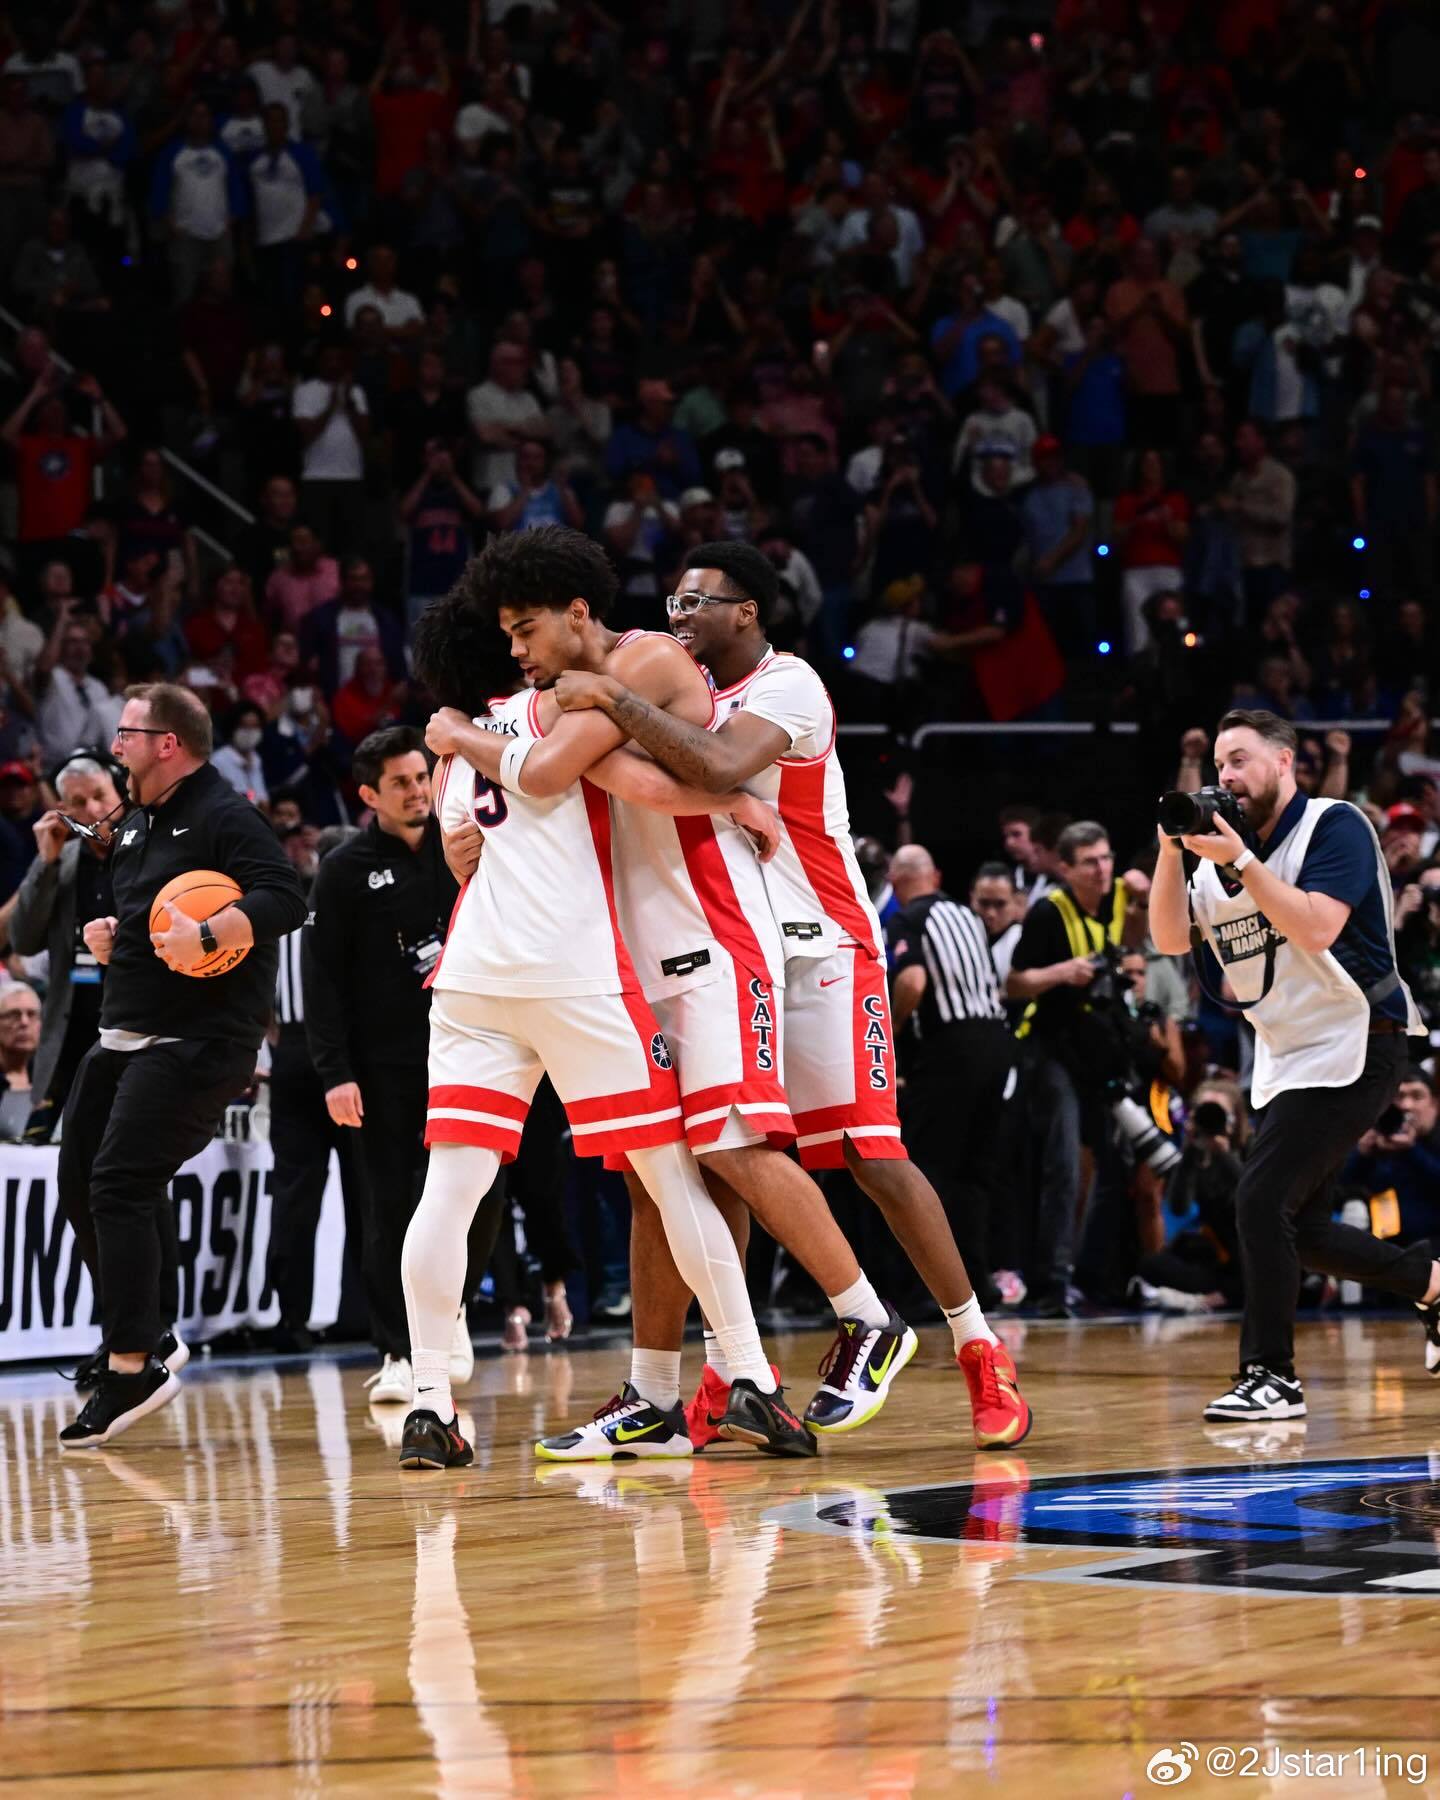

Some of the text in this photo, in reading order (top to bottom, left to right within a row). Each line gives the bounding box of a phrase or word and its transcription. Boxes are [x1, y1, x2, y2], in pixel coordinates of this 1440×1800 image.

[473, 768, 508, 828] 5
[1231, 928, 1281, 955] MADN
[750, 978, 773, 1070] CATS
[863, 995, 888, 1091] CATS
